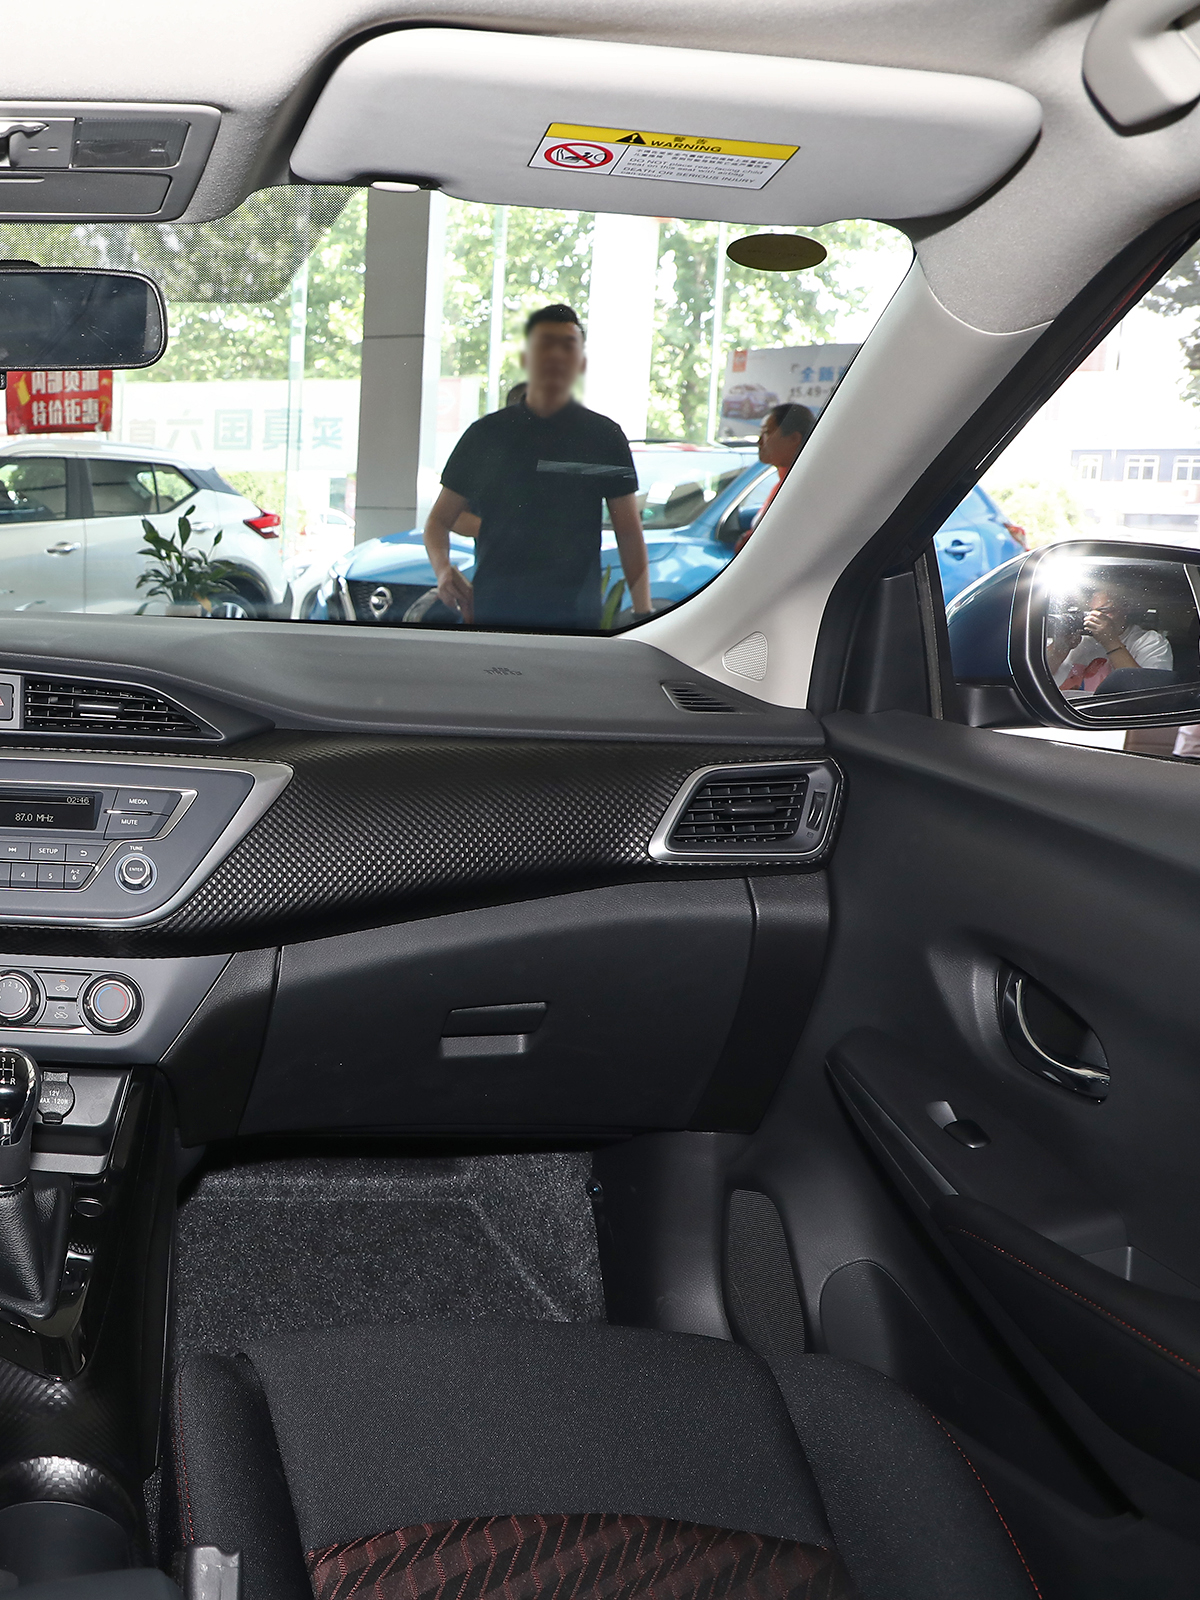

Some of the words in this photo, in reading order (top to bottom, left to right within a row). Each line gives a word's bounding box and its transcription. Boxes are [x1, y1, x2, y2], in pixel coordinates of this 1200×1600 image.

[651, 140, 722, 153] WARNING
[66, 796, 90, 804] 02:46
[14, 813, 33, 822] 87.0
[36, 814, 54, 823] MHz
[120, 818, 139, 826] MUTE
[38, 847, 59, 855] SETUP
[0, 1077, 6, 1085] 4
